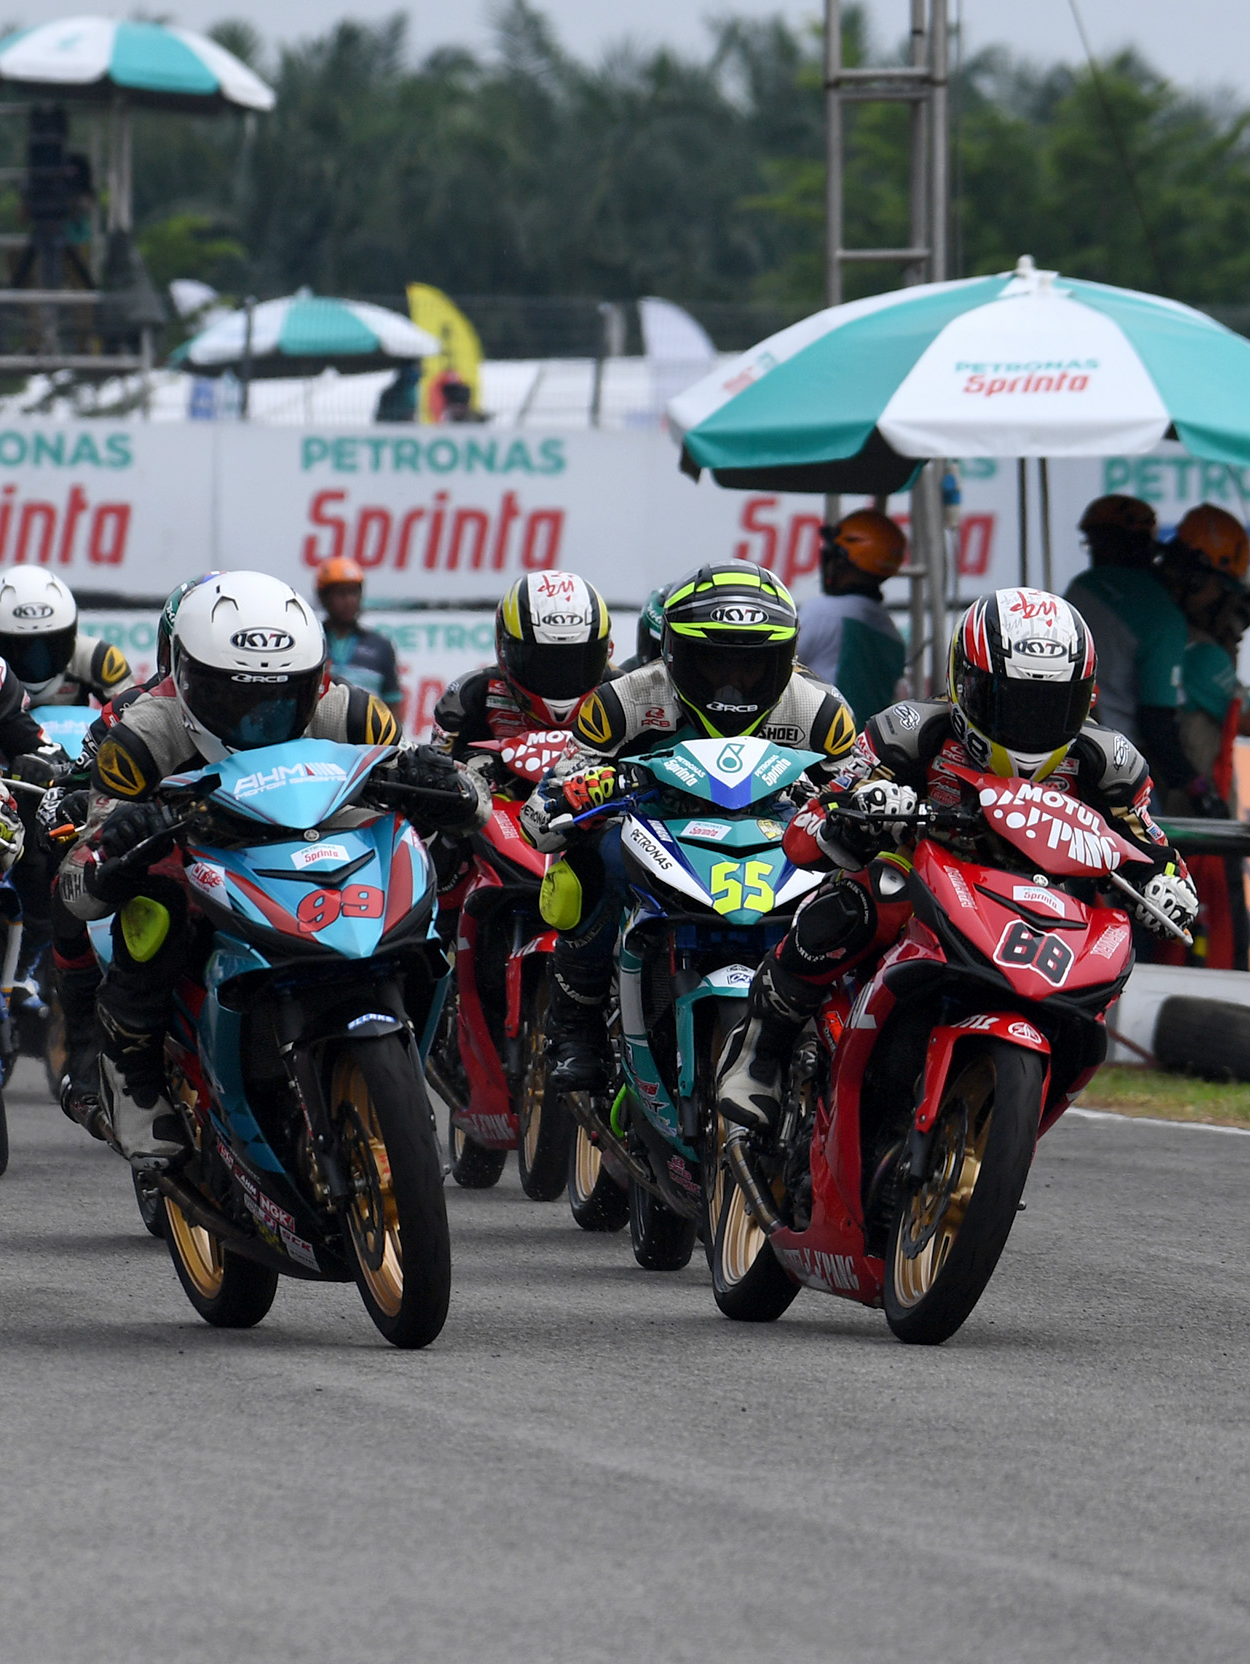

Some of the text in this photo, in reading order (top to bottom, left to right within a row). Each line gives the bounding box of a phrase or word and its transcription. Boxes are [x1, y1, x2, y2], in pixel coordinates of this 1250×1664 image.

[955, 358, 1100, 376] PETRONAS
[962, 373, 1091, 397] Sprinta
[300, 436, 567, 476] PETRONAS
[301, 488, 566, 572] Sprinta
[15, 604, 53, 618] KYT
[549, 614, 580, 624] KYT
[717, 607, 763, 622] KYT
[239, 632, 288, 650] KYT
[1023, 642, 1061, 655] KYT
[641, 719, 671, 728] RCB
[758, 728, 799, 742] SHOEI
[663, 758, 699, 787] Sprinta
[675, 755, 706, 779] PETRONAS
[754, 754, 780, 777] PETRONAS
[761, 757, 792, 787] Sprinta
[233, 763, 306, 795] AHM
[1016, 783, 1101, 837] MOTUL
[304, 848, 340, 863] Sprinta
[629, 827, 673, 871] PETRONAS
[709, 859, 776, 916] 55
[295, 882, 386, 934] 99
[1023, 890, 1059, 911] Sprinta
[260, 1197, 290, 1226] NGK
